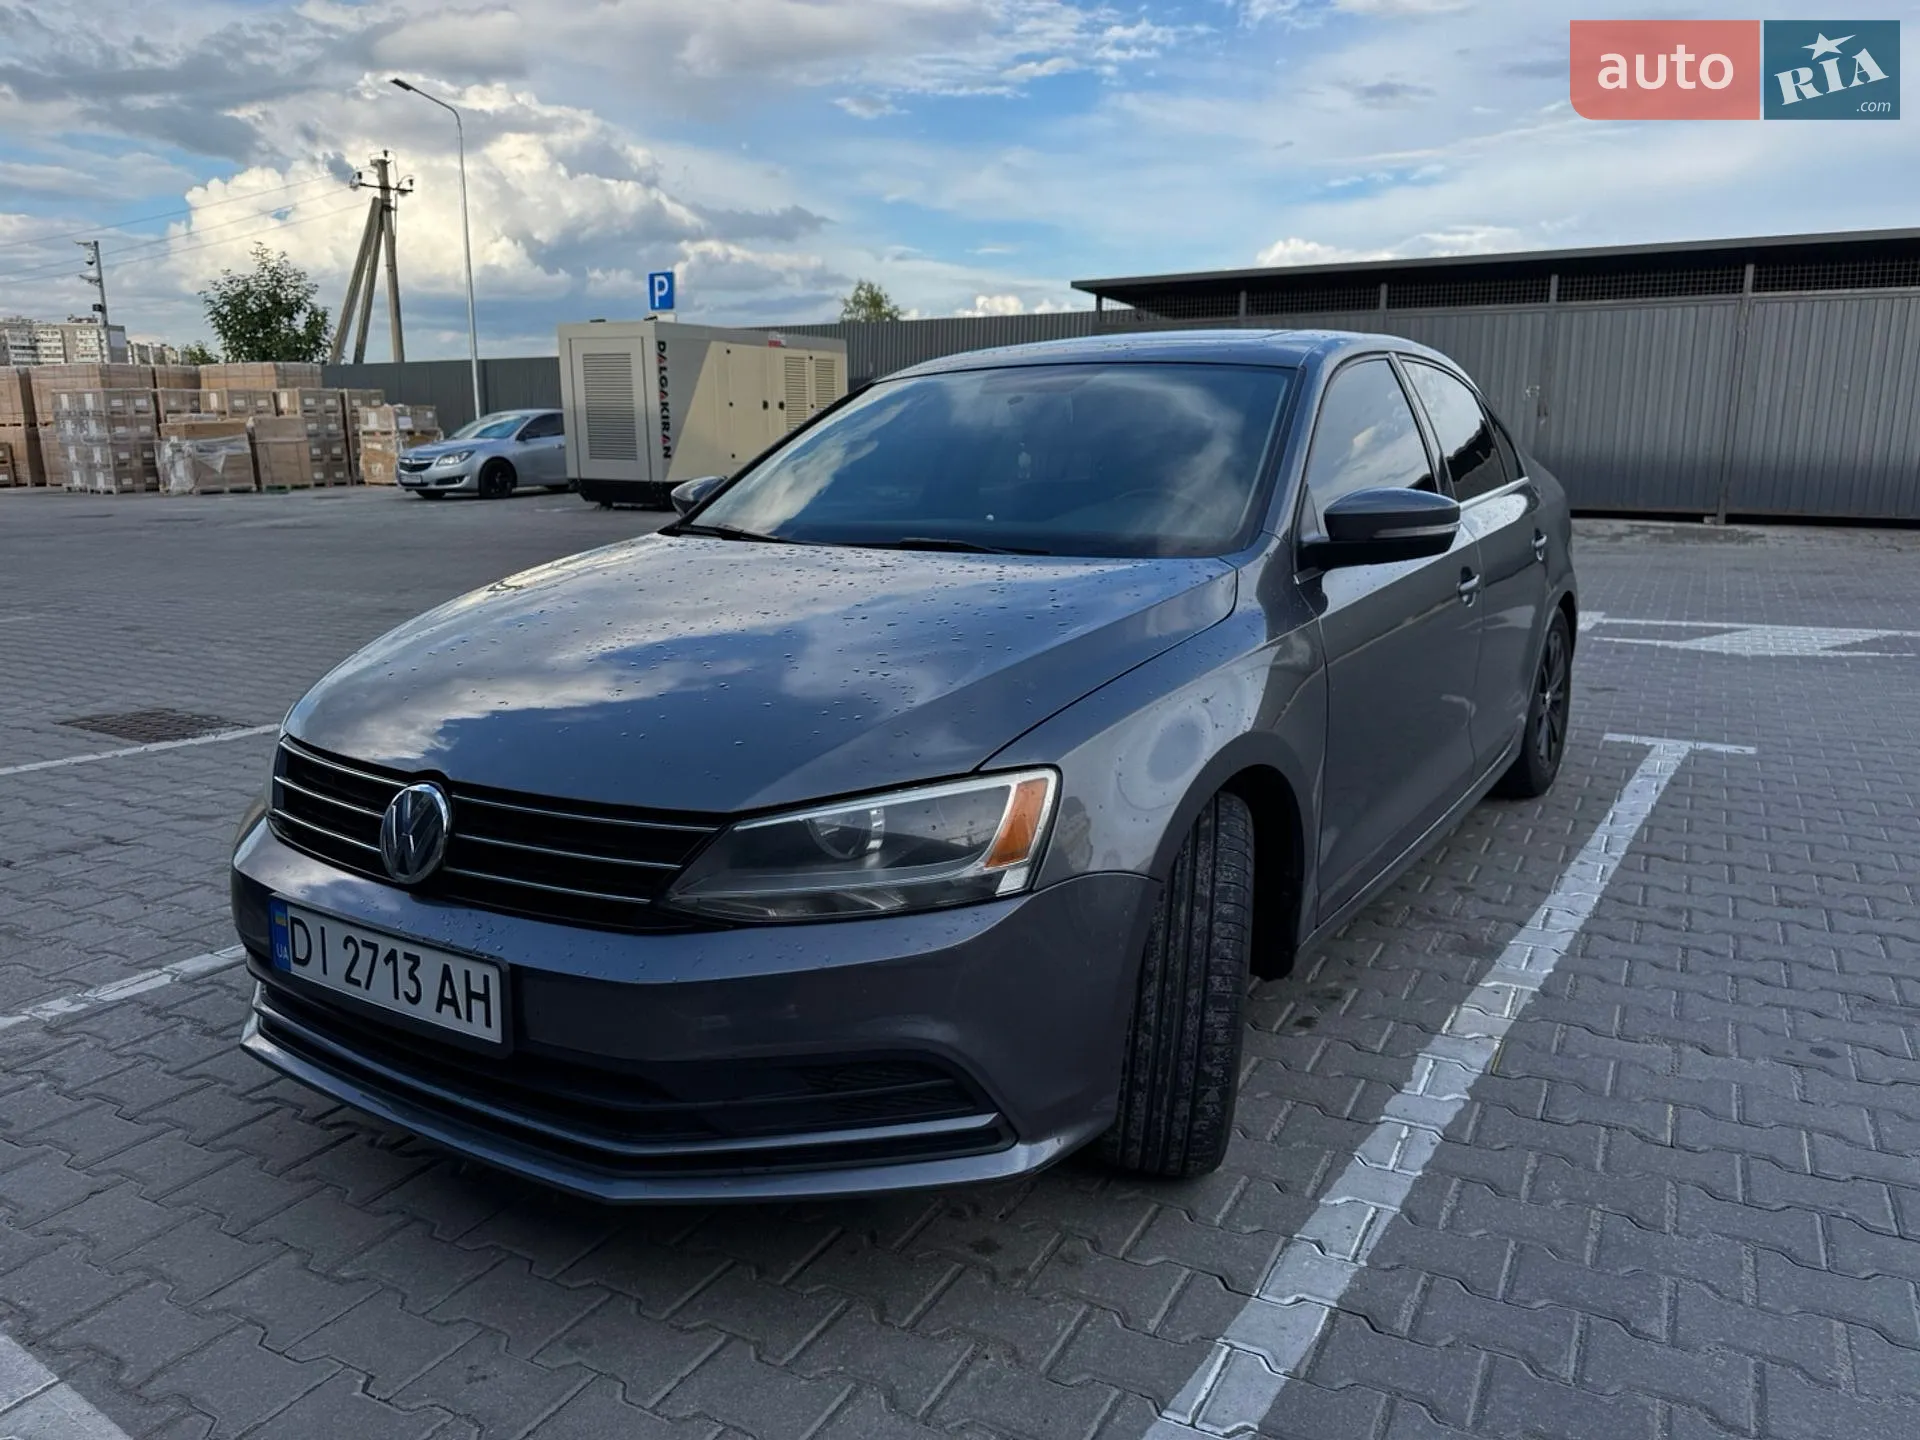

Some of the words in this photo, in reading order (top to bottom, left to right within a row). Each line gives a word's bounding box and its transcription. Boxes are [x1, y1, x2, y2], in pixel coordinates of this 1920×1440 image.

[654, 275, 669, 308] P
[657, 340, 671, 459] DALGAKIRAN
[276, 942, 289, 959] UA
[290, 916, 327, 976] DI
[343, 935, 423, 1006] 2713
[435, 963, 492, 1029] AH
